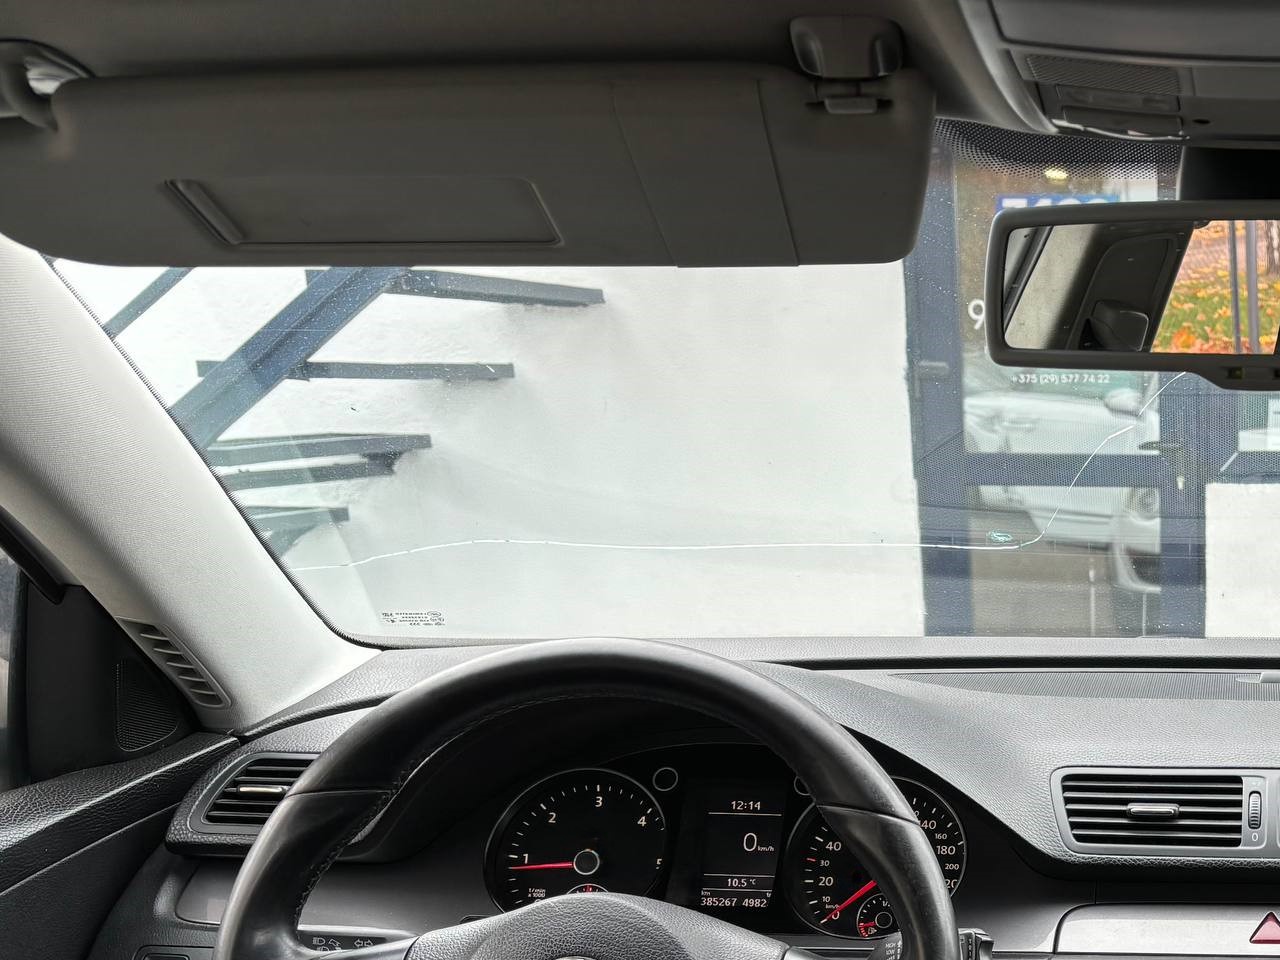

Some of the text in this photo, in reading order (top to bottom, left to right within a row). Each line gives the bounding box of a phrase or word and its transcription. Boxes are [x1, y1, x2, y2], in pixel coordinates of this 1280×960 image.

[594, 796, 603, 808] 3
[731, 800, 761, 811] 12:14
[548, 812, 556, 824] 2
[637, 815, 647, 827] 4
[918, 819, 937, 830] 40
[743, 832, 758, 852] 0
[825, 841, 842, 851] 40
[936, 845, 956, 855] 180
[522, 853, 529, 864] 1
[820, 859, 830, 867] 30
[944, 863, 960, 871] 200
[727, 878, 747, 888] 10.5
[818, 876, 834, 886] 20
[700, 897, 738, 907] 385267
